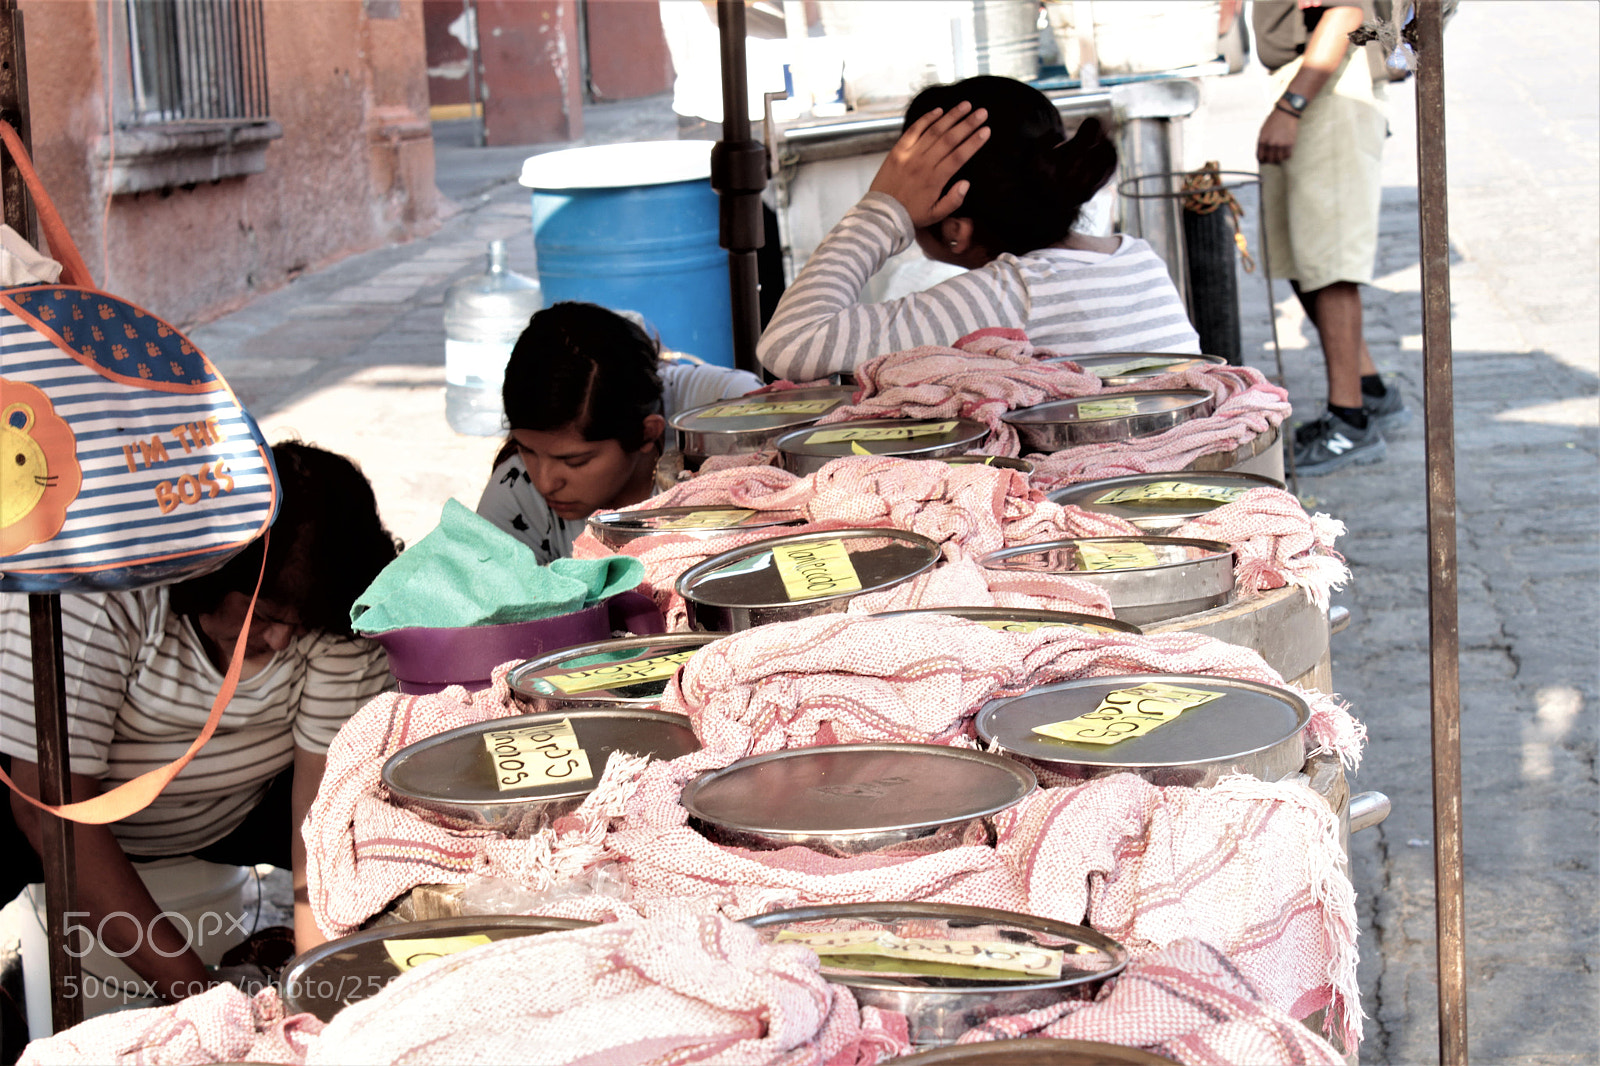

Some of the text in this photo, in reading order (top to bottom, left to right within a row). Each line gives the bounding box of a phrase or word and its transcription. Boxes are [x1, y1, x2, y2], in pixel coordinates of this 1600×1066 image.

[122, 415, 228, 474] I'M THE
[154, 457, 235, 514] BOSS
